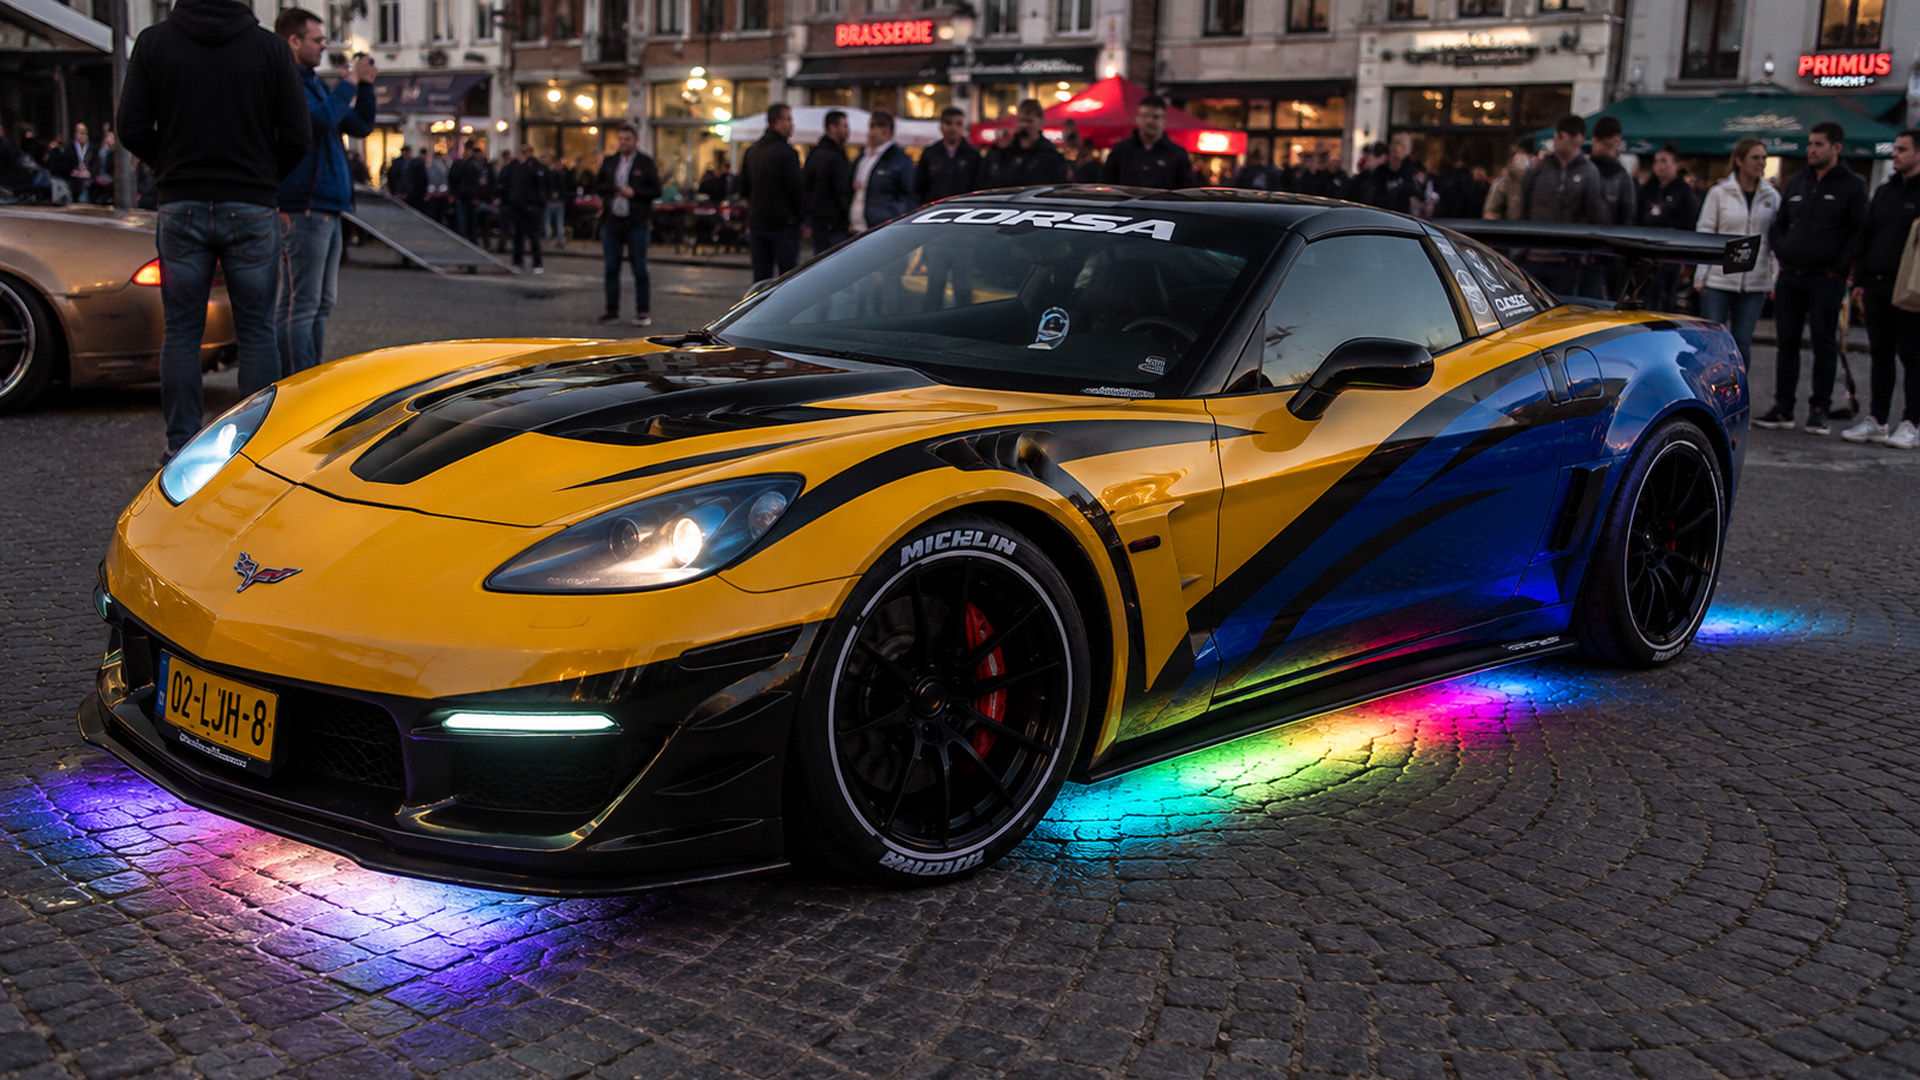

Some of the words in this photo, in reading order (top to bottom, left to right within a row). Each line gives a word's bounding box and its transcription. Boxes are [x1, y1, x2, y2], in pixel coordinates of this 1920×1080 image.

[835, 20, 933, 47] BRASSERIE
[1798, 53, 1892, 77] PRIMUS
[911, 208, 1176, 242] CORSA
[171, 670, 267, 746] 02-LJH-8
